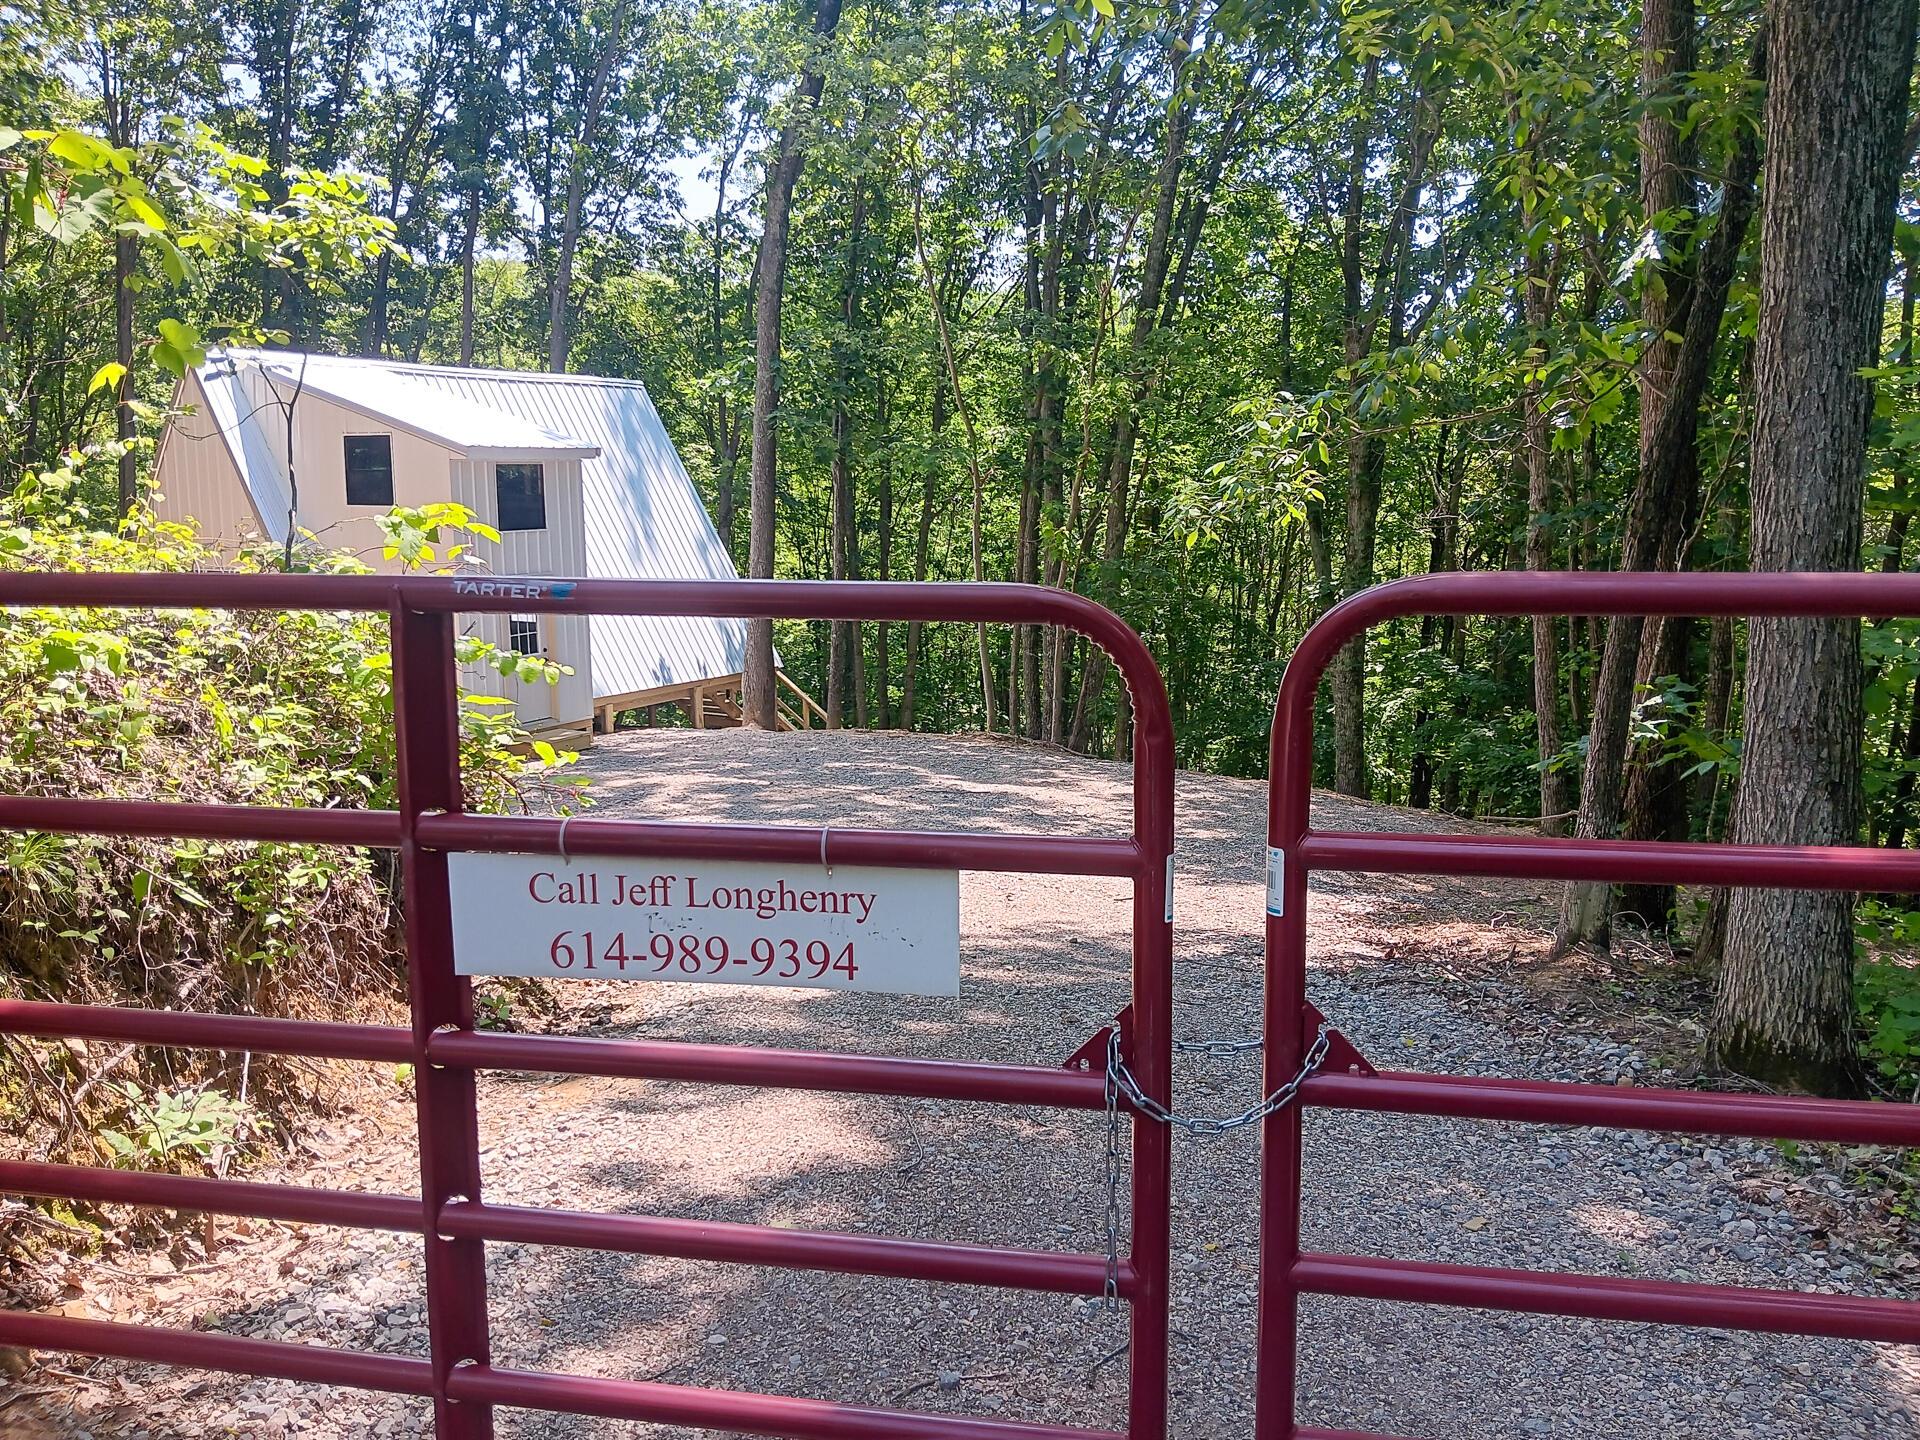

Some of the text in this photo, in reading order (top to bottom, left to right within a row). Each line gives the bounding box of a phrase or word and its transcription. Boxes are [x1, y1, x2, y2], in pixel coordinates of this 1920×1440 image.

[454, 581, 542, 599] TARTER
[529, 872, 600, 905] Call
[612, 874, 677, 906] Jeff
[686, 876, 878, 923] Longhenry
[550, 930, 859, 981] 614-989-9394
